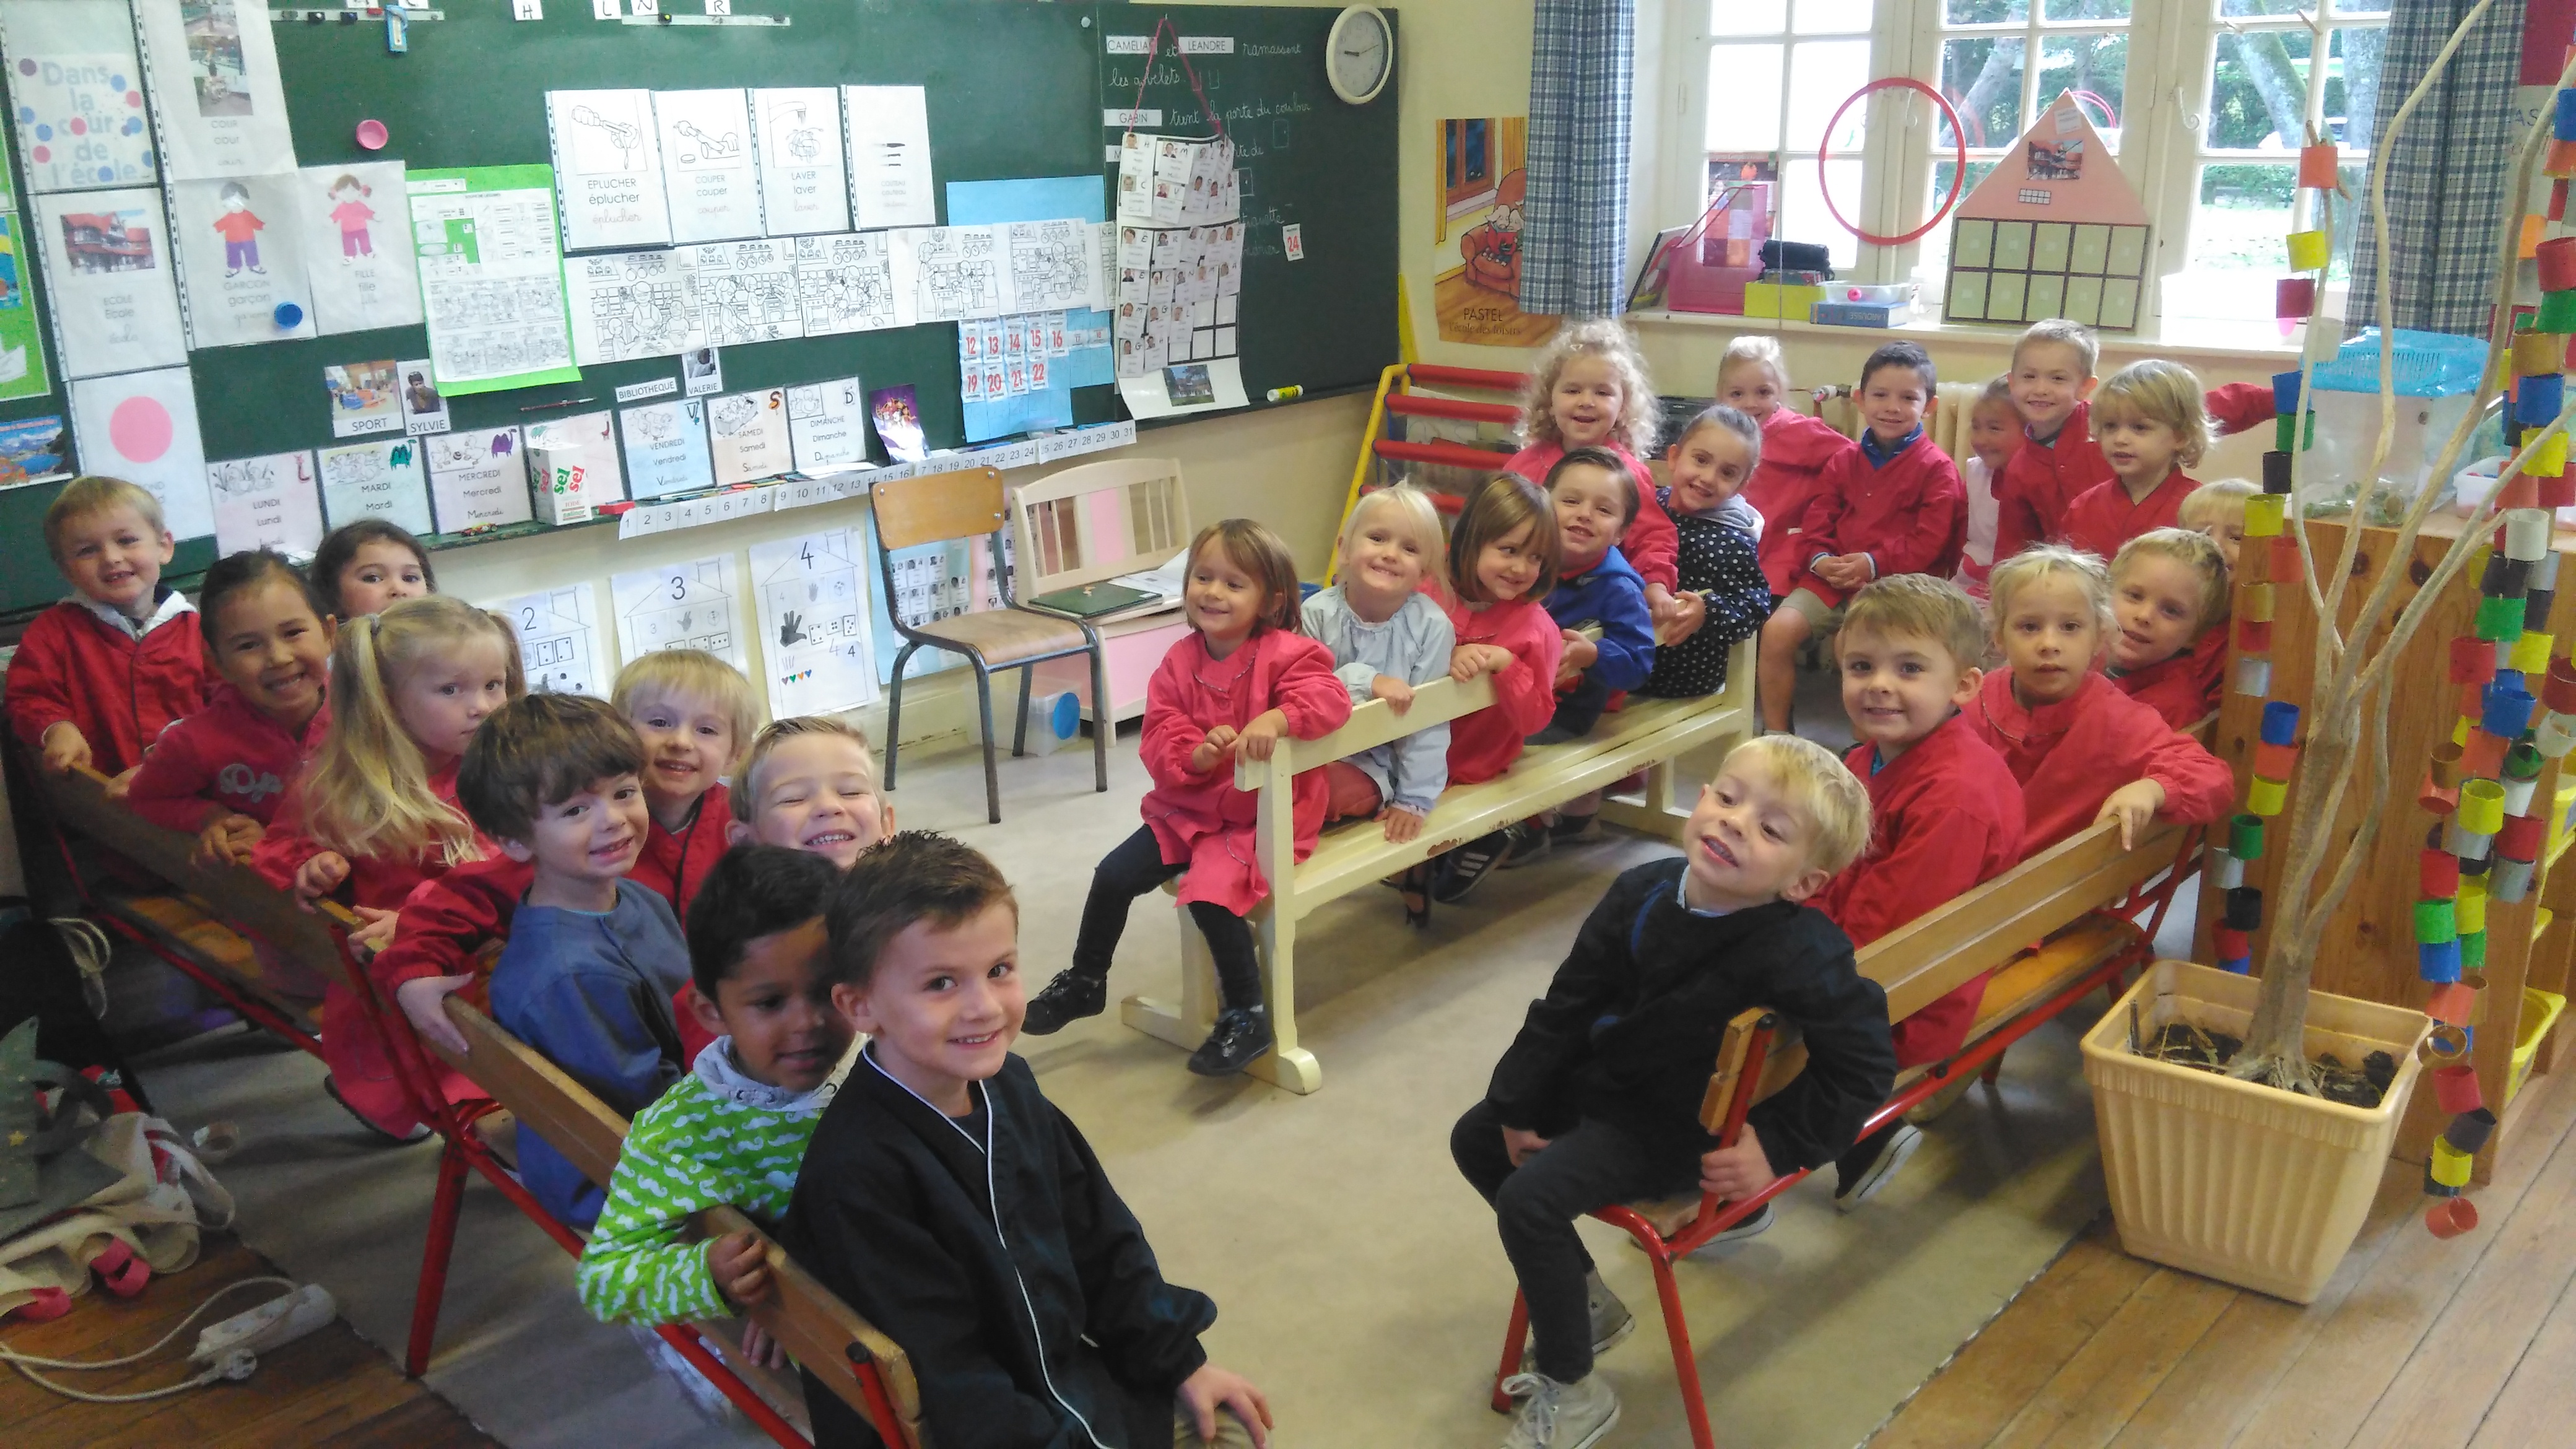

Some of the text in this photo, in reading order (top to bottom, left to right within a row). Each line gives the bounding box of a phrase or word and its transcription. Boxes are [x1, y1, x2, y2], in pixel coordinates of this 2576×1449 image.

[523, 4, 533, 19] H
[713, 0, 724, 13] R
[1188, 41, 1225, 50] LEANDRE
[1243, 43, 1302, 56] ramassent
[41, 62, 110, 86] Dans
[1108, 67, 1129, 87] les
[69, 88, 95, 111] la
[1120, 113, 1147, 123] GABIN
[1256, 98, 1271, 117] du
[212, 120, 238, 128] COUR
[214, 136, 239, 144] cour
[75, 137, 108, 161] de
[695, 175, 725, 184] COUPER
[791, 171, 817, 181] LAVER
[588, 178, 637, 189] EPLUCHER
[794, 185, 817, 194] laver
[697, 187, 728, 197] couper
[589, 193, 640, 206] éplucher
[593, 208, 642, 229] éplucher
[1288, 235, 1300, 253] 24
[355, 269, 375, 278] FILLE
[359, 282, 376, 292] fille
[104, 295, 133, 306] ECOLE
[228, 294, 271, 307] garçon
[105, 308, 134, 319] Ecole
[1464, 308, 1503, 321] PASTEL
[967, 336, 976, 355] 12
[988, 336, 998, 354] 13
[1009, 334, 1020, 352] 14
[1030, 329, 1041, 347] 15
[1052, 330, 1063, 347] 16
[967, 374, 977, 392] 19
[988, 373, 1001, 393] 20
[1012, 370, 1022, 387] 21
[1032, 363, 1044, 381] 22
[619, 381, 675, 399] BIBLIOTHEQUE
[689, 383, 718, 394] VALERIE
[352, 418, 388, 432] SPORT
[410, 420, 446, 433] SYLVIE
[811, 416, 845, 427] DIMANCHE
[738, 429, 763, 438] SAMEDI
[813, 432, 846, 442] Dimanche
[650, 438, 685, 450] VENDREDI
[739, 442, 765, 453] Samedi
[653, 454, 686, 466] Vendredi
[459, 469, 500, 481] MERCREDI
[554, 465, 585, 495] sel sel
[625, 519, 630, 528] 1
[644, 515, 651, 524] 2
[665, 512, 671, 521] 3
[684, 508, 692, 518] 4
[705, 505, 711, 515] 5
[724, 502, 730, 511] 6
[743, 498, 749, 507] 7
[760, 495, 767, 503] 8
[780, 491, 786, 500] 9
[796, 489, 808, 497] 10
[816, 486, 825, 495] 11
[833, 483, 844, 492] 12
[851, 480, 860, 489] 13
[884, 472, 893, 481] 15
[900, 470, 909, 478] 16
[933, 464, 942, 473] 18
[950, 461, 959, 470] 19
[965, 459, 975, 468] 20
[980, 456, 991, 466] 21
[995, 453, 1005, 463] 22
[1010, 451, 1020, 460] 23
[1025, 447, 1034, 456] 24
[1053, 442, 1063, 451] 26
[1068, 438, 1077, 448] 27
[1082, 436, 1092, 445] 28
[1096, 433, 1106, 442] 29
[1110, 430, 1120, 440] 30
[1124, 427, 1133, 437] 31
[362, 484, 391, 494] MARDI
[463, 487, 502, 498] Mercredi
[253, 499, 280, 509] LUNDI
[367, 500, 393, 511] Mardi
[257, 516, 282, 526] Lundi
[800, 542, 815, 570] 4
[671, 576, 685, 600] 3
[522, 607, 537, 631] 2
[650, 622, 656, 634] 3
[848, 645, 856, 658] 4
